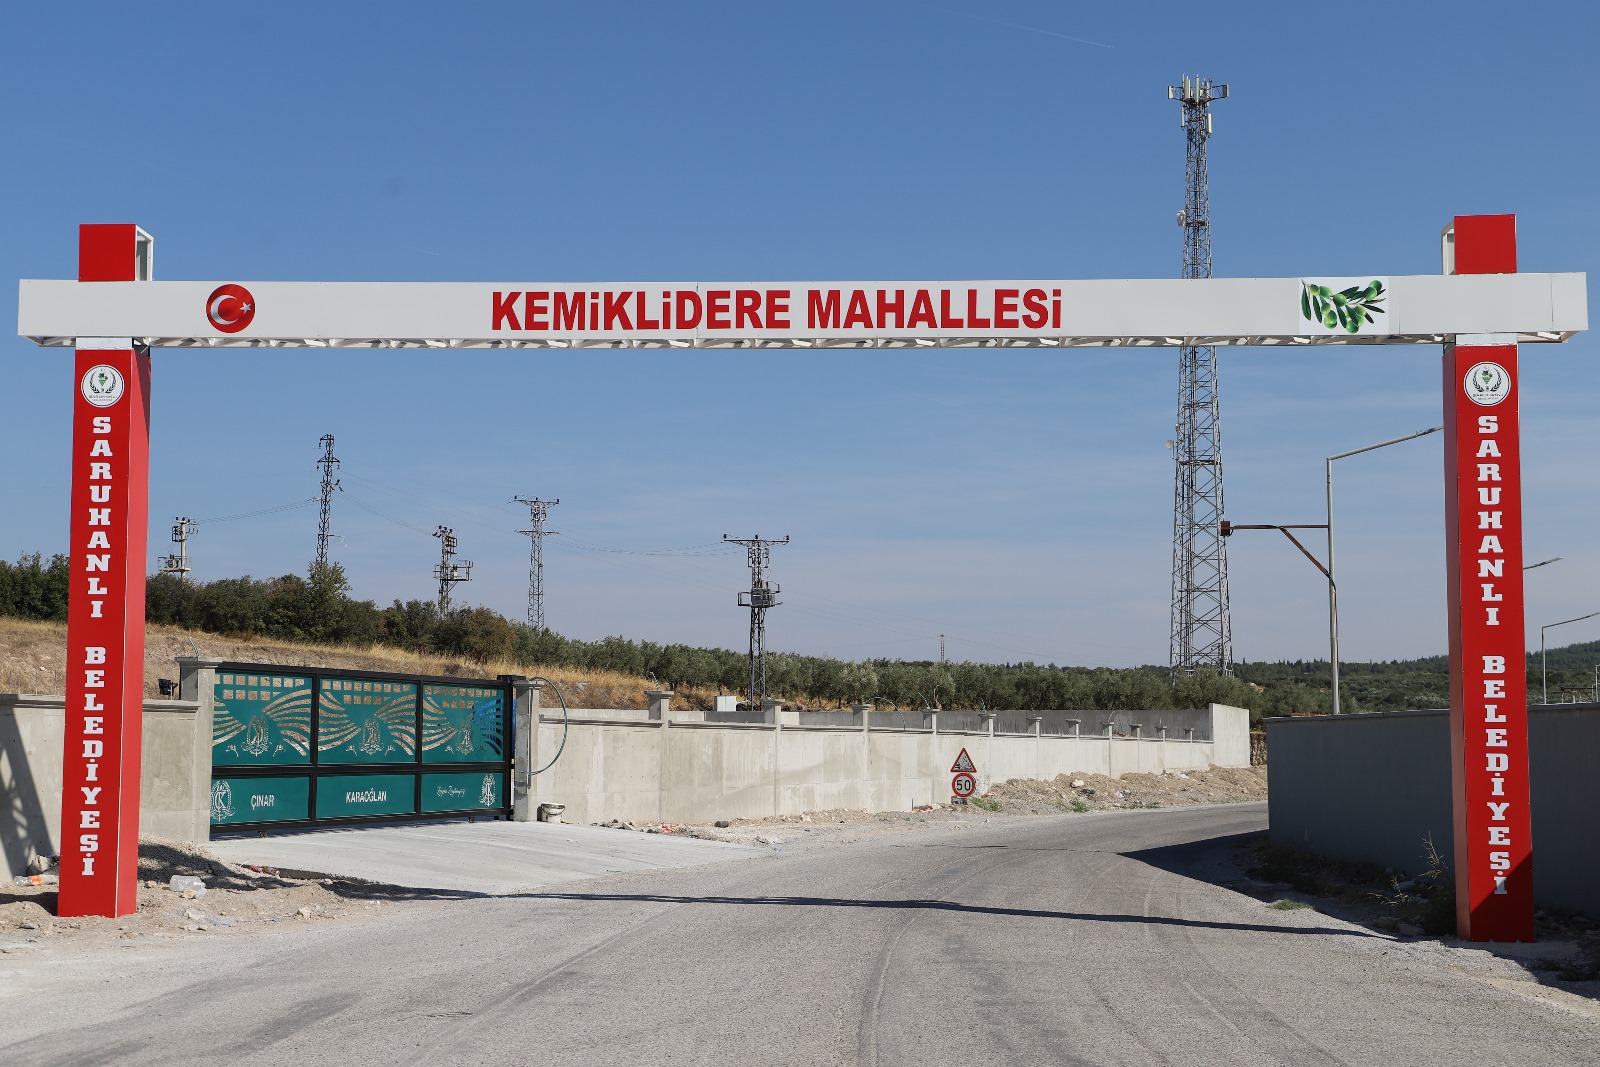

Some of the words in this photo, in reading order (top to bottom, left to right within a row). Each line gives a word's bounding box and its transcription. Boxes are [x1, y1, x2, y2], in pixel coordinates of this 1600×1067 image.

[86, 416, 113, 618] SARUHANLI
[1476, 415, 1504, 626] SARUHANLI
[79, 646, 107, 876] BELEDİYESİ
[250, 794, 275, 810] ÇINAR
[345, 787, 387, 803] KARAOĞLAN
[956, 779, 971, 791] 50
[1482, 655, 1511, 895] BELEDİYESİ
